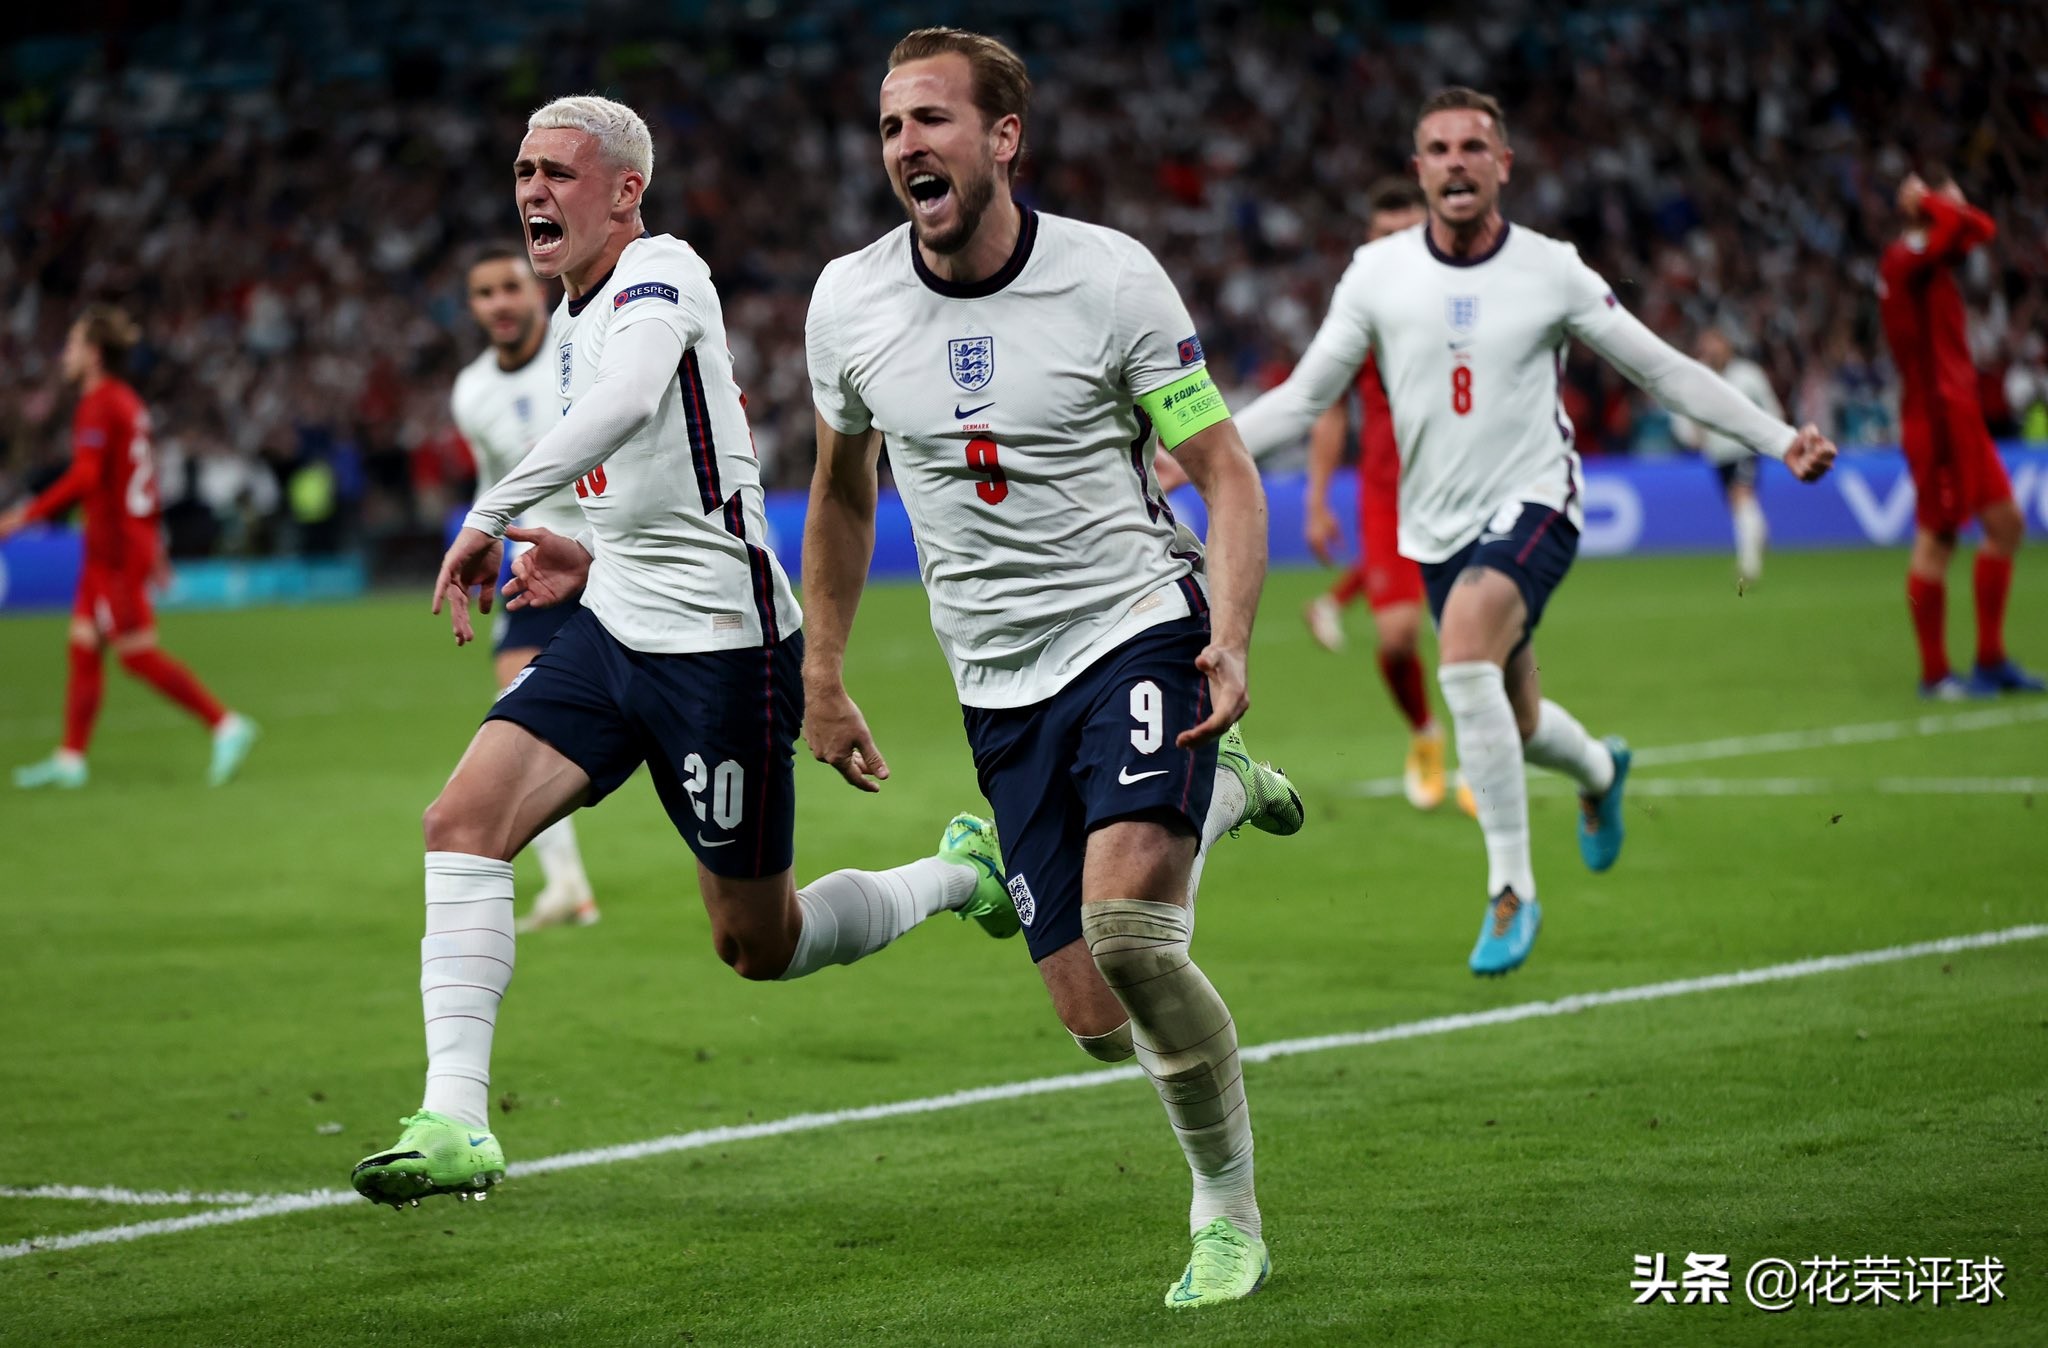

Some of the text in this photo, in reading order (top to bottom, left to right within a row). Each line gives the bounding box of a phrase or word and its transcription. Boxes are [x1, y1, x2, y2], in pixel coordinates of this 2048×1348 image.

[629, 286, 678, 299] RESPECT
[1190, 393, 1223, 414] RESPEC
[1452, 366, 1473, 416] 8
[962, 423, 990, 431] DENMARK
[964, 435, 1009, 506] 9
[1129, 680, 1164, 755] 9
[682, 752, 745, 830] 20
